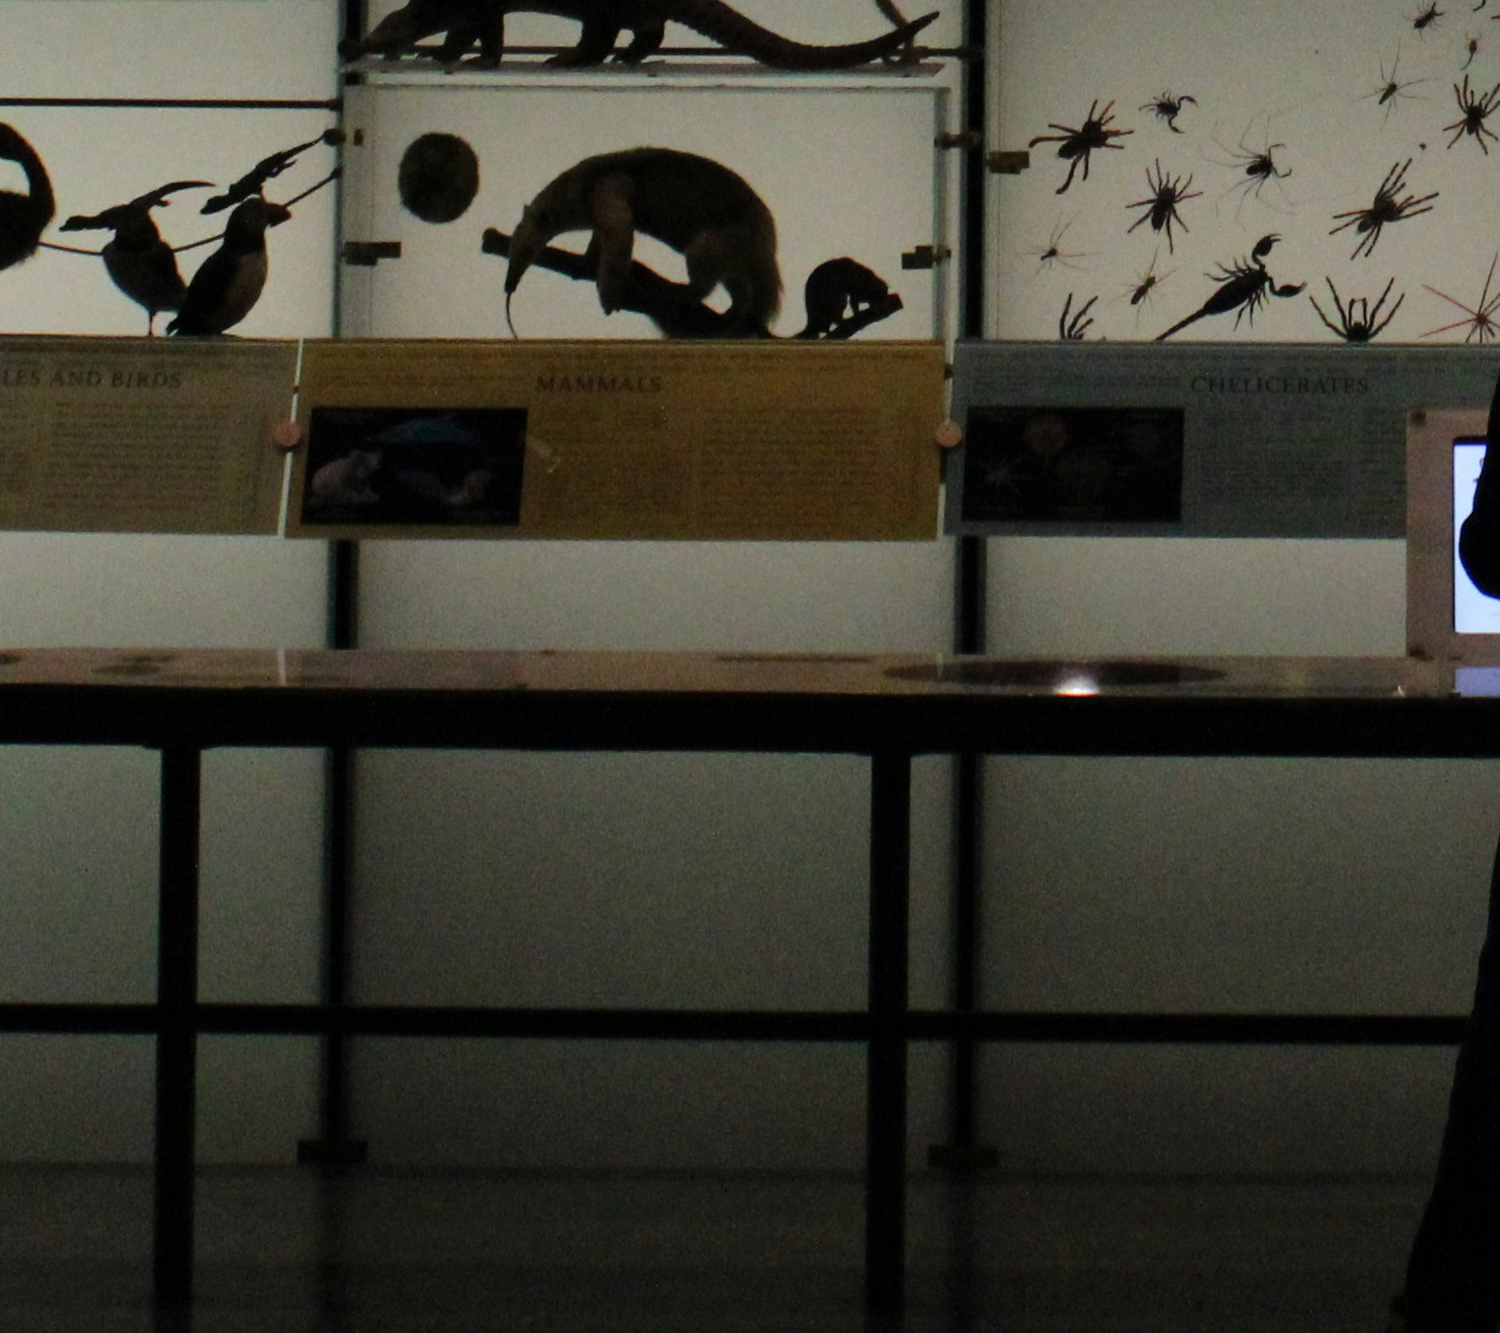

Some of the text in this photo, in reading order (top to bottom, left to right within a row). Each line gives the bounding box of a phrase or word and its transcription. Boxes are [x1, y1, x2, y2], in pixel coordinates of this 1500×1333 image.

[50, 369, 102, 387] AND
[110, 370, 182, 389] BIRDS
[535, 375, 663, 394] MAMMALS
[1190, 375, 1370, 395] CHELICERATES
